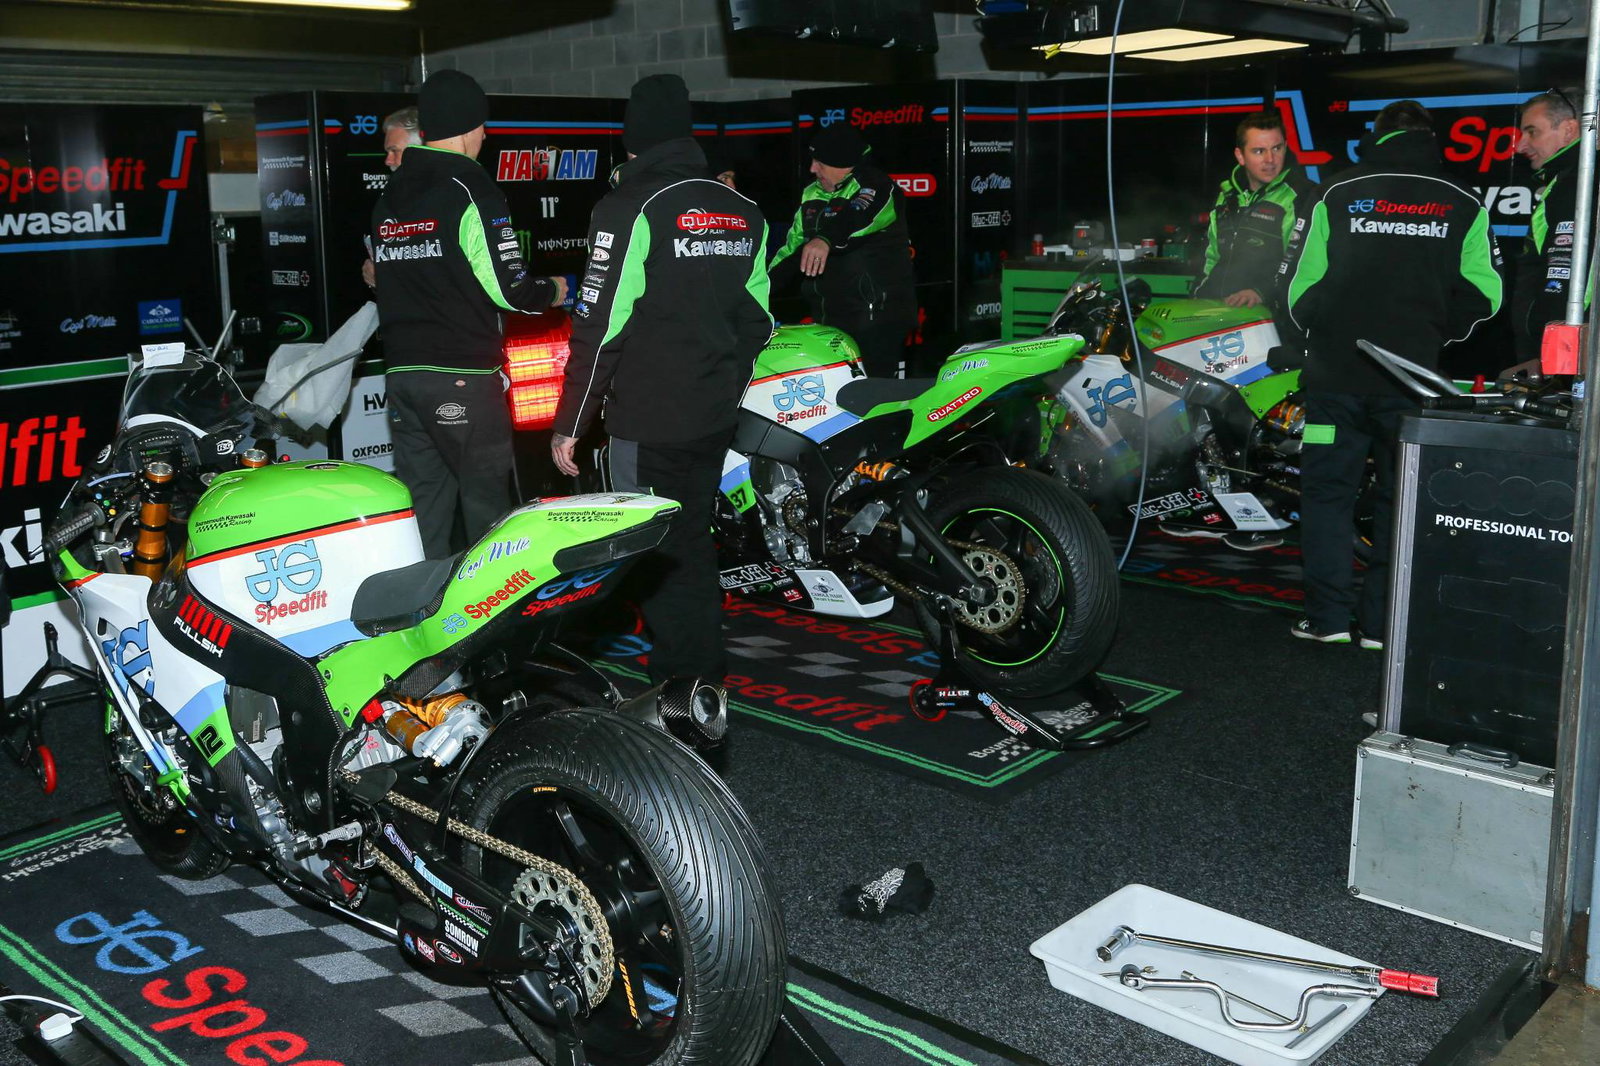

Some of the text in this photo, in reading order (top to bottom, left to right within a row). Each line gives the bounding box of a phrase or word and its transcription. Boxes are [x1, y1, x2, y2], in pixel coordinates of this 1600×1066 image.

[850, 104, 925, 129] Speedfit
[0, 203, 127, 236] wasaki
[681, 214, 747, 228] QUATTRO
[1374, 199, 1453, 218] Speedfit
[380, 221, 434, 235] QUATTRO
[1350, 218, 1449, 239] Kawasaki
[375, 239, 443, 263] Kwasaki
[673, 237, 753, 258] Kawasaki
[776, 404, 827, 425] Speedfit
[928, 387, 980, 421] QUATTRO
[352, 443, 394, 458] OXFORD
[730, 487, 749, 508] 37
[225, 512, 256, 521] Kawasaki
[1435, 514, 1546, 541] PROFESSIONAL
[464, 568, 536, 619] Speedfit
[522, 582, 603, 617] Speedfit
[254, 590, 328, 625] Speedfit
[173, 616, 224, 658] FULLSIX
[989, 703, 1028, 735] Speedfit
[444, 919, 479, 951] SOMROW
[141, 965, 346, 1066] Spe
